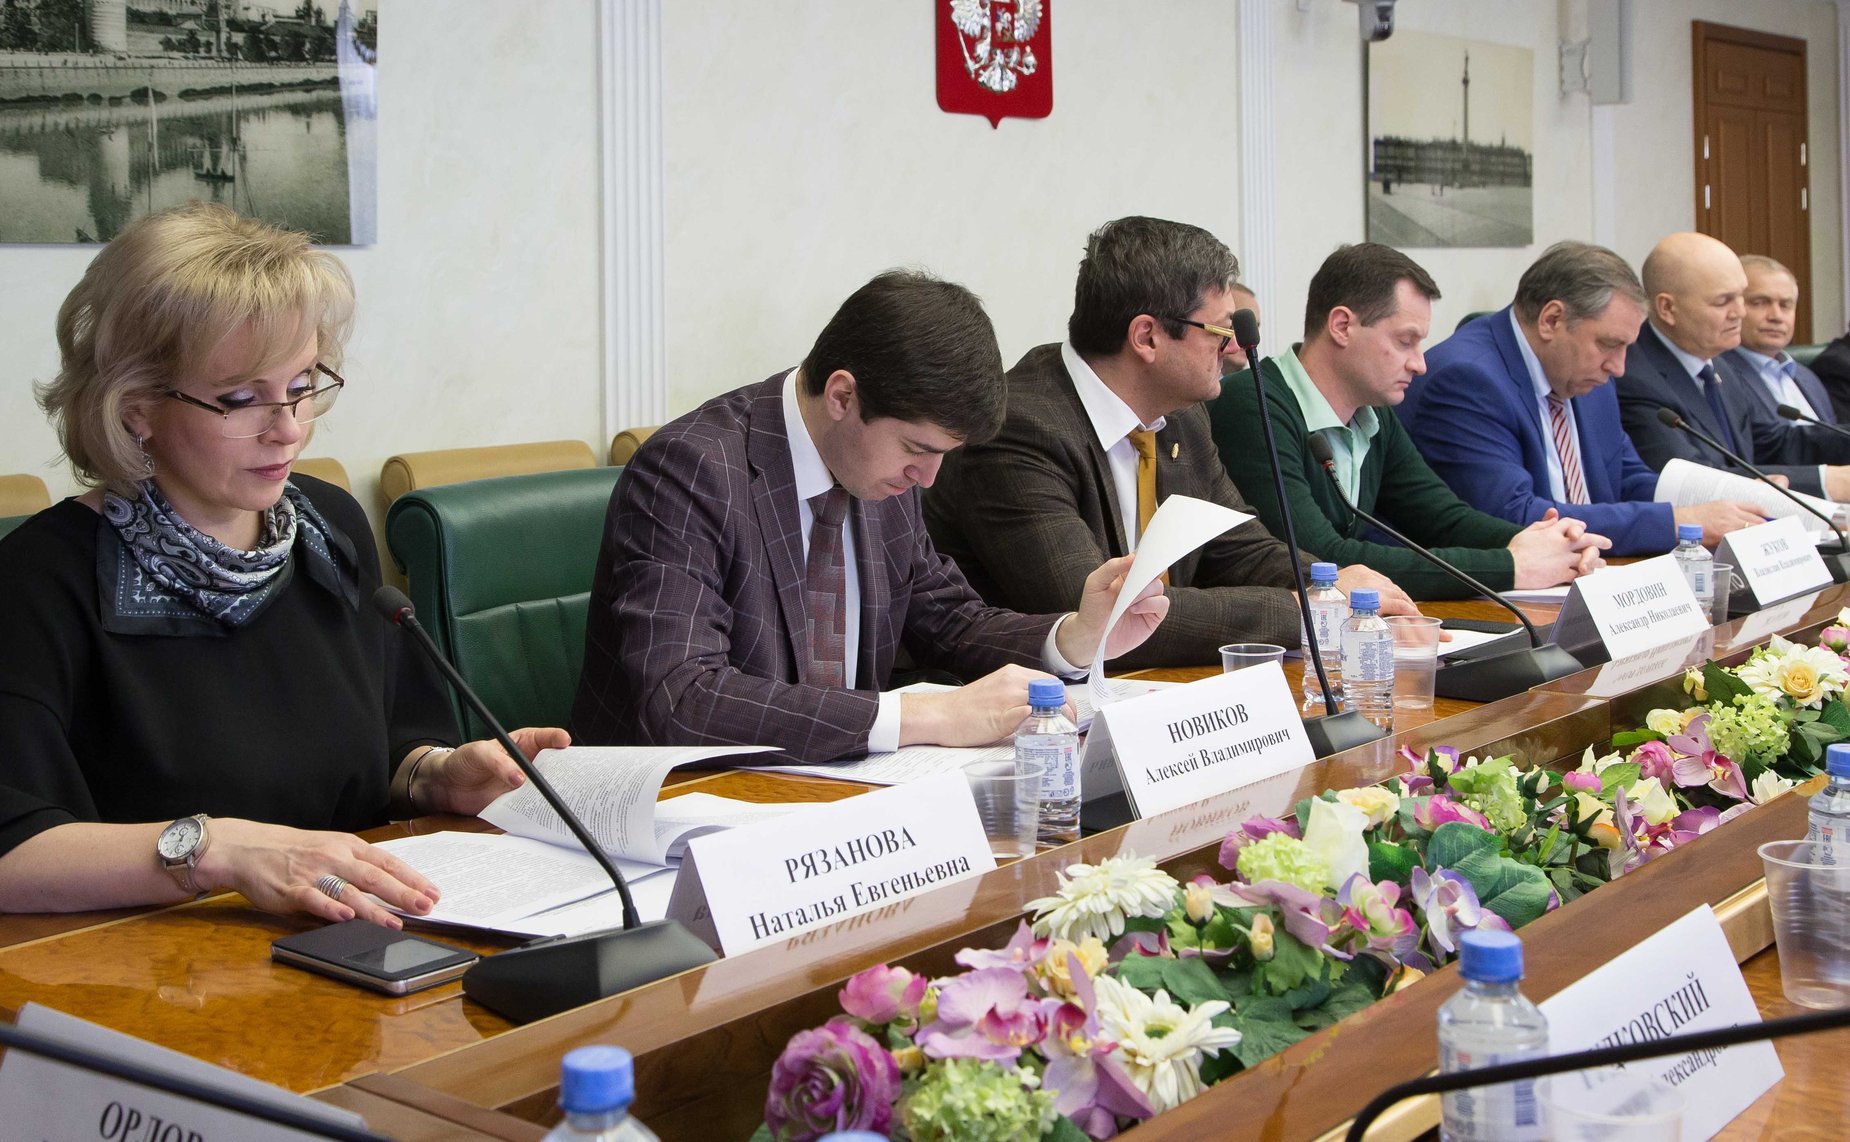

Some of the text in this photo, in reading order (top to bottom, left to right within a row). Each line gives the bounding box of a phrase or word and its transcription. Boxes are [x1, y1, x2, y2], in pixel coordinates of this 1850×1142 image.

[1608, 602, 1693, 637] Александр Николаевич
[1612, 581, 1668, 609] МОРДОВИН
[1166, 703, 1249, 744] НОВИКОВ
[1145, 727, 1291, 786] Алексей Владимирович
[784, 825, 917, 884] РЯЗАНОВА
[748, 893, 849, 941] Наталья
[849, 855, 971, 908] Евгеньевна
